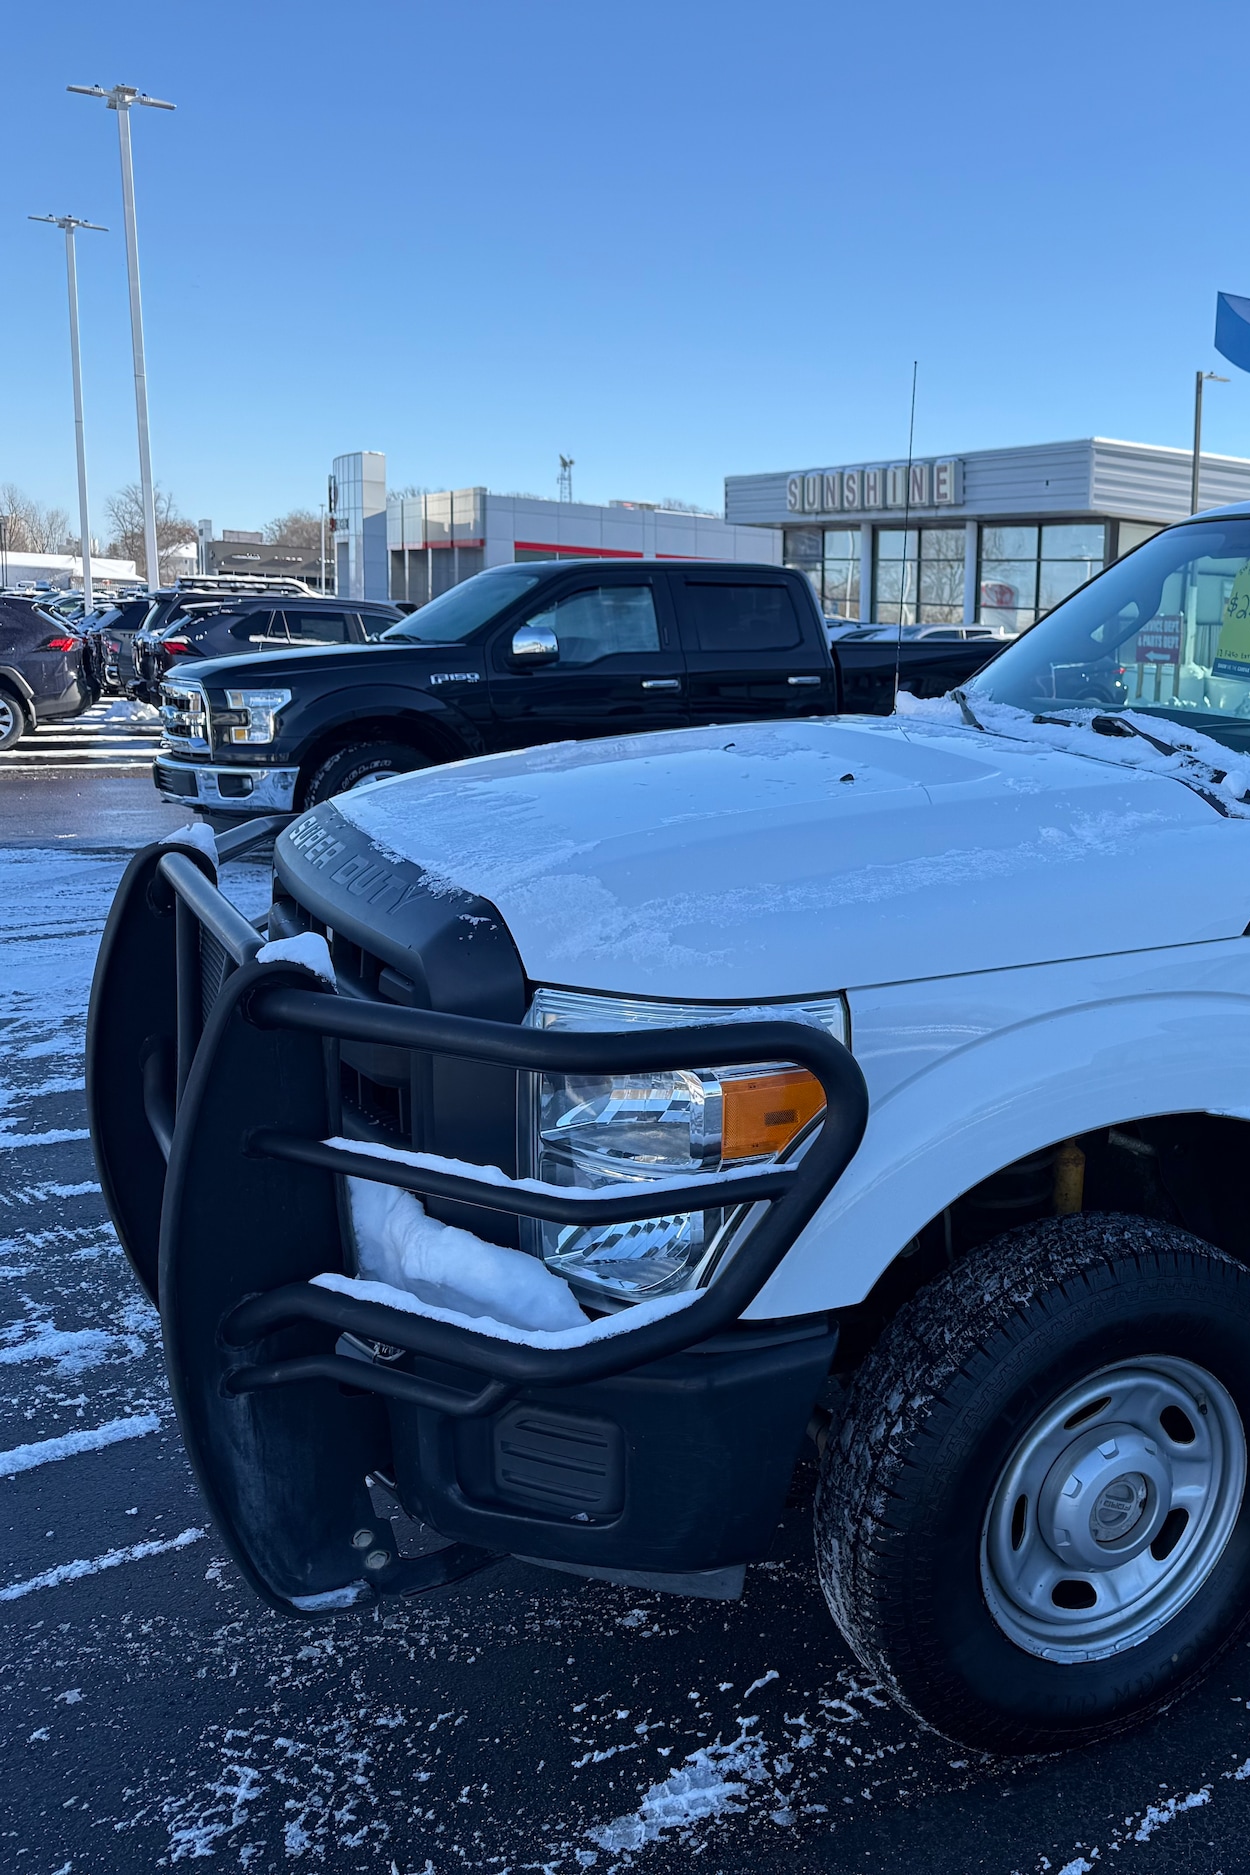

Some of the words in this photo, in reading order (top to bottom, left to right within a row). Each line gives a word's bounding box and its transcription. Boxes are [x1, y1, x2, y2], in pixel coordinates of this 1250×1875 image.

[787, 465, 949, 511] SUNSHINE
[288, 815, 348, 870] SUPER
[329, 854, 429, 916] DUTY
